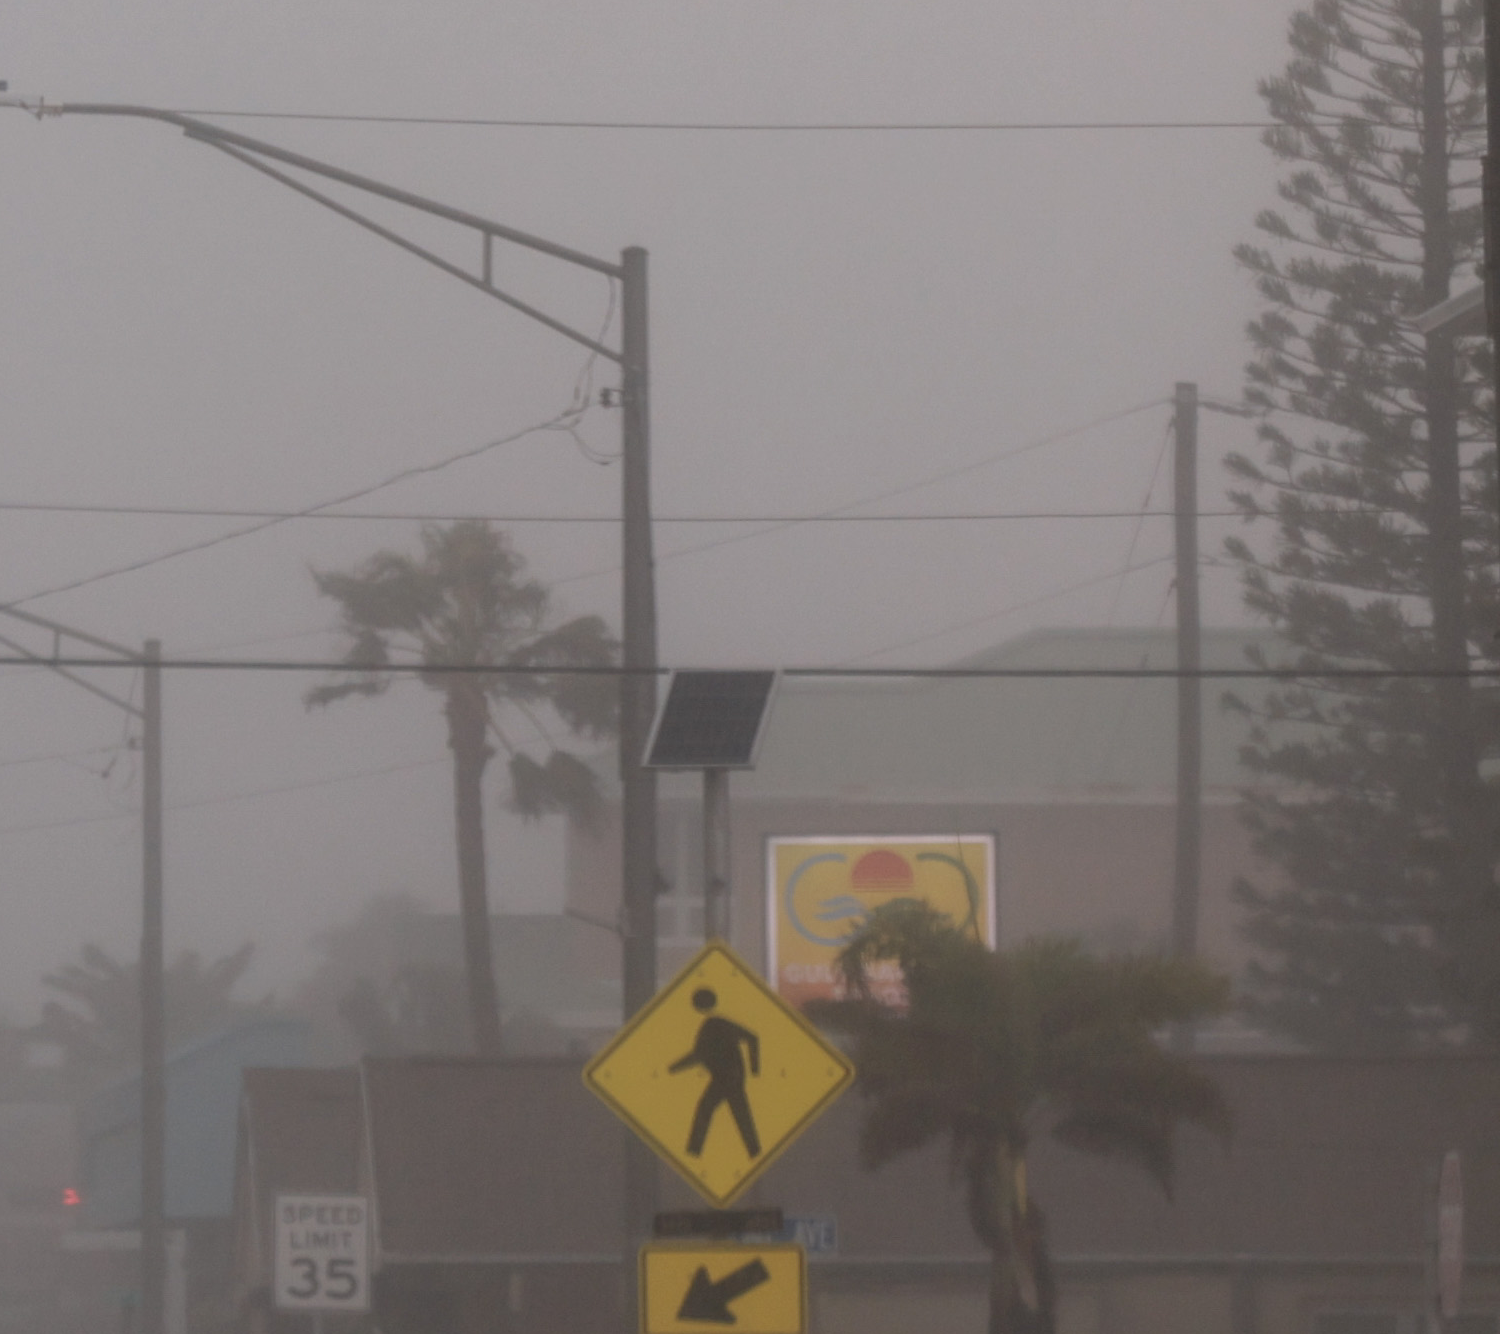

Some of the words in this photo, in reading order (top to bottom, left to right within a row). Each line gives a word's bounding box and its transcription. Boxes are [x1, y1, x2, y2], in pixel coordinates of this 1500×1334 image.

[282, 1204, 364, 1226] SPEED
[289, 1231, 353, 1249] LIMIT
[286, 1257, 358, 1300] 35
